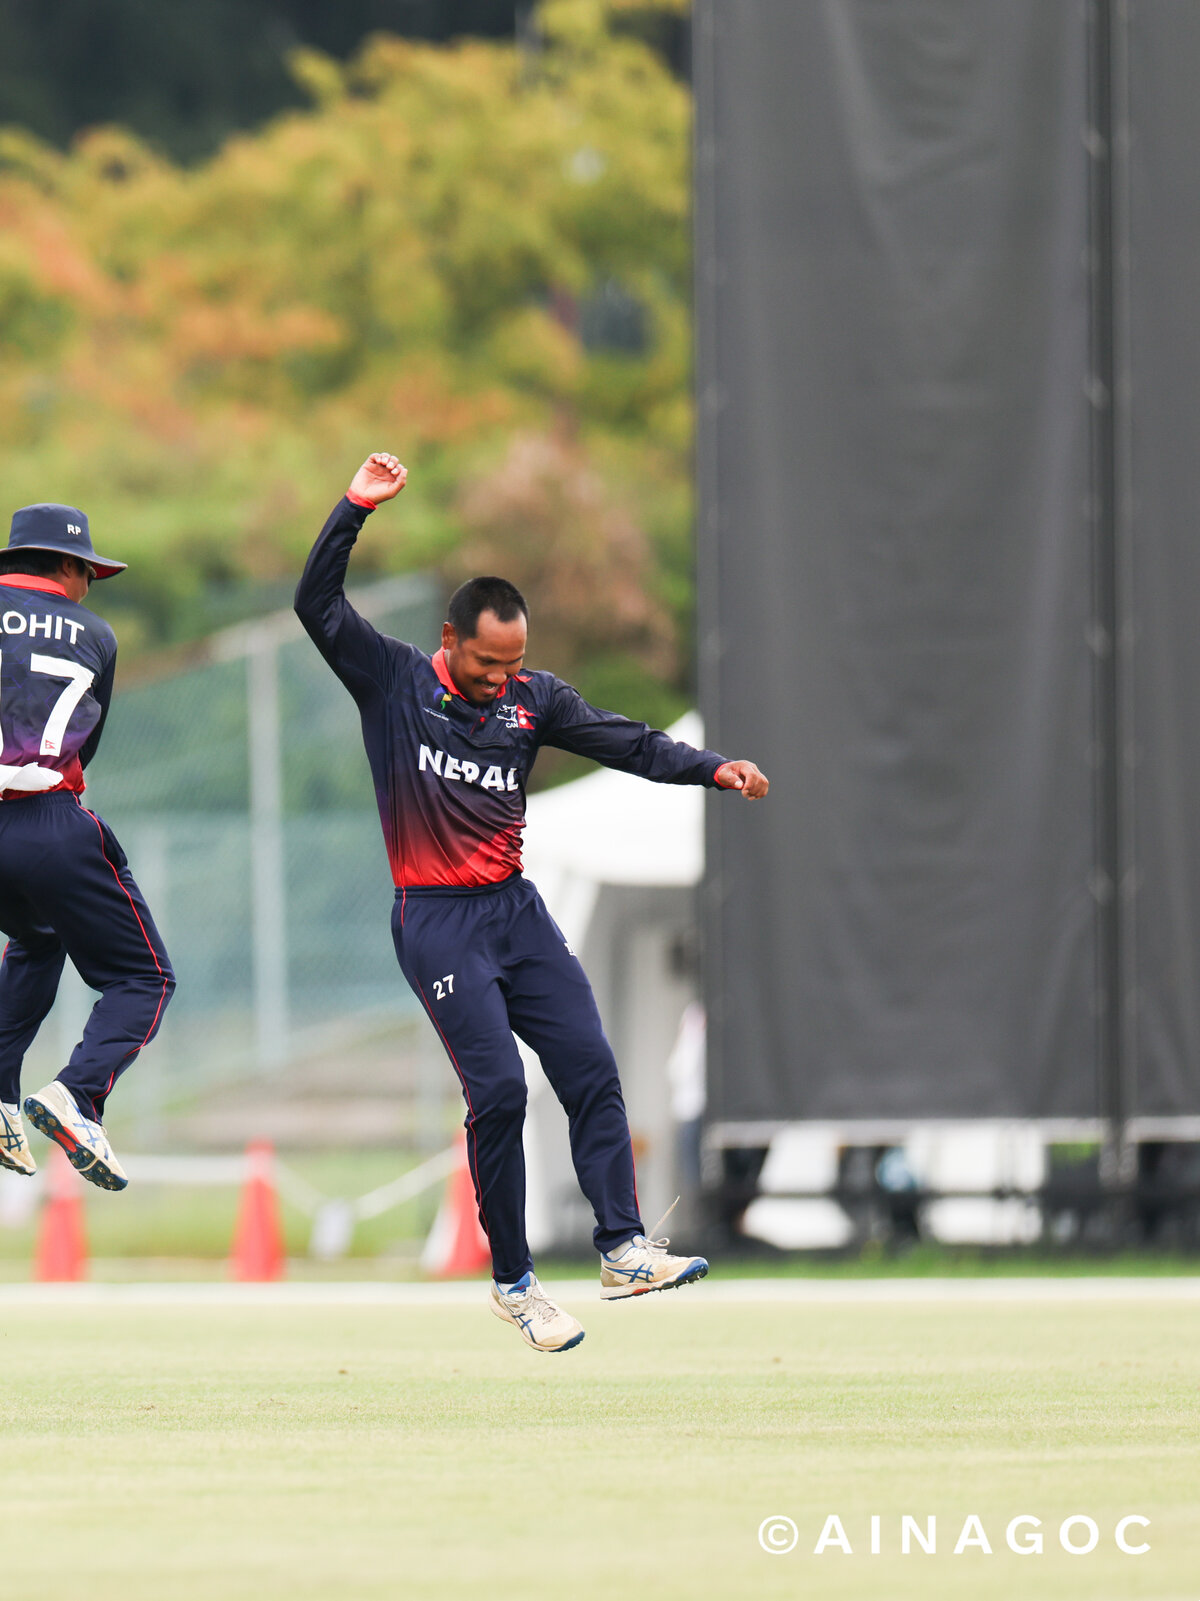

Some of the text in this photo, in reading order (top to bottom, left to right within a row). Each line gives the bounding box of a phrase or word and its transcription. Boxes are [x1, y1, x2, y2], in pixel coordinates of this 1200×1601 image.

[67, 524, 81, 535] RP
[418, 743, 519, 792] NEPAL
[432, 974, 455, 1001] 27
